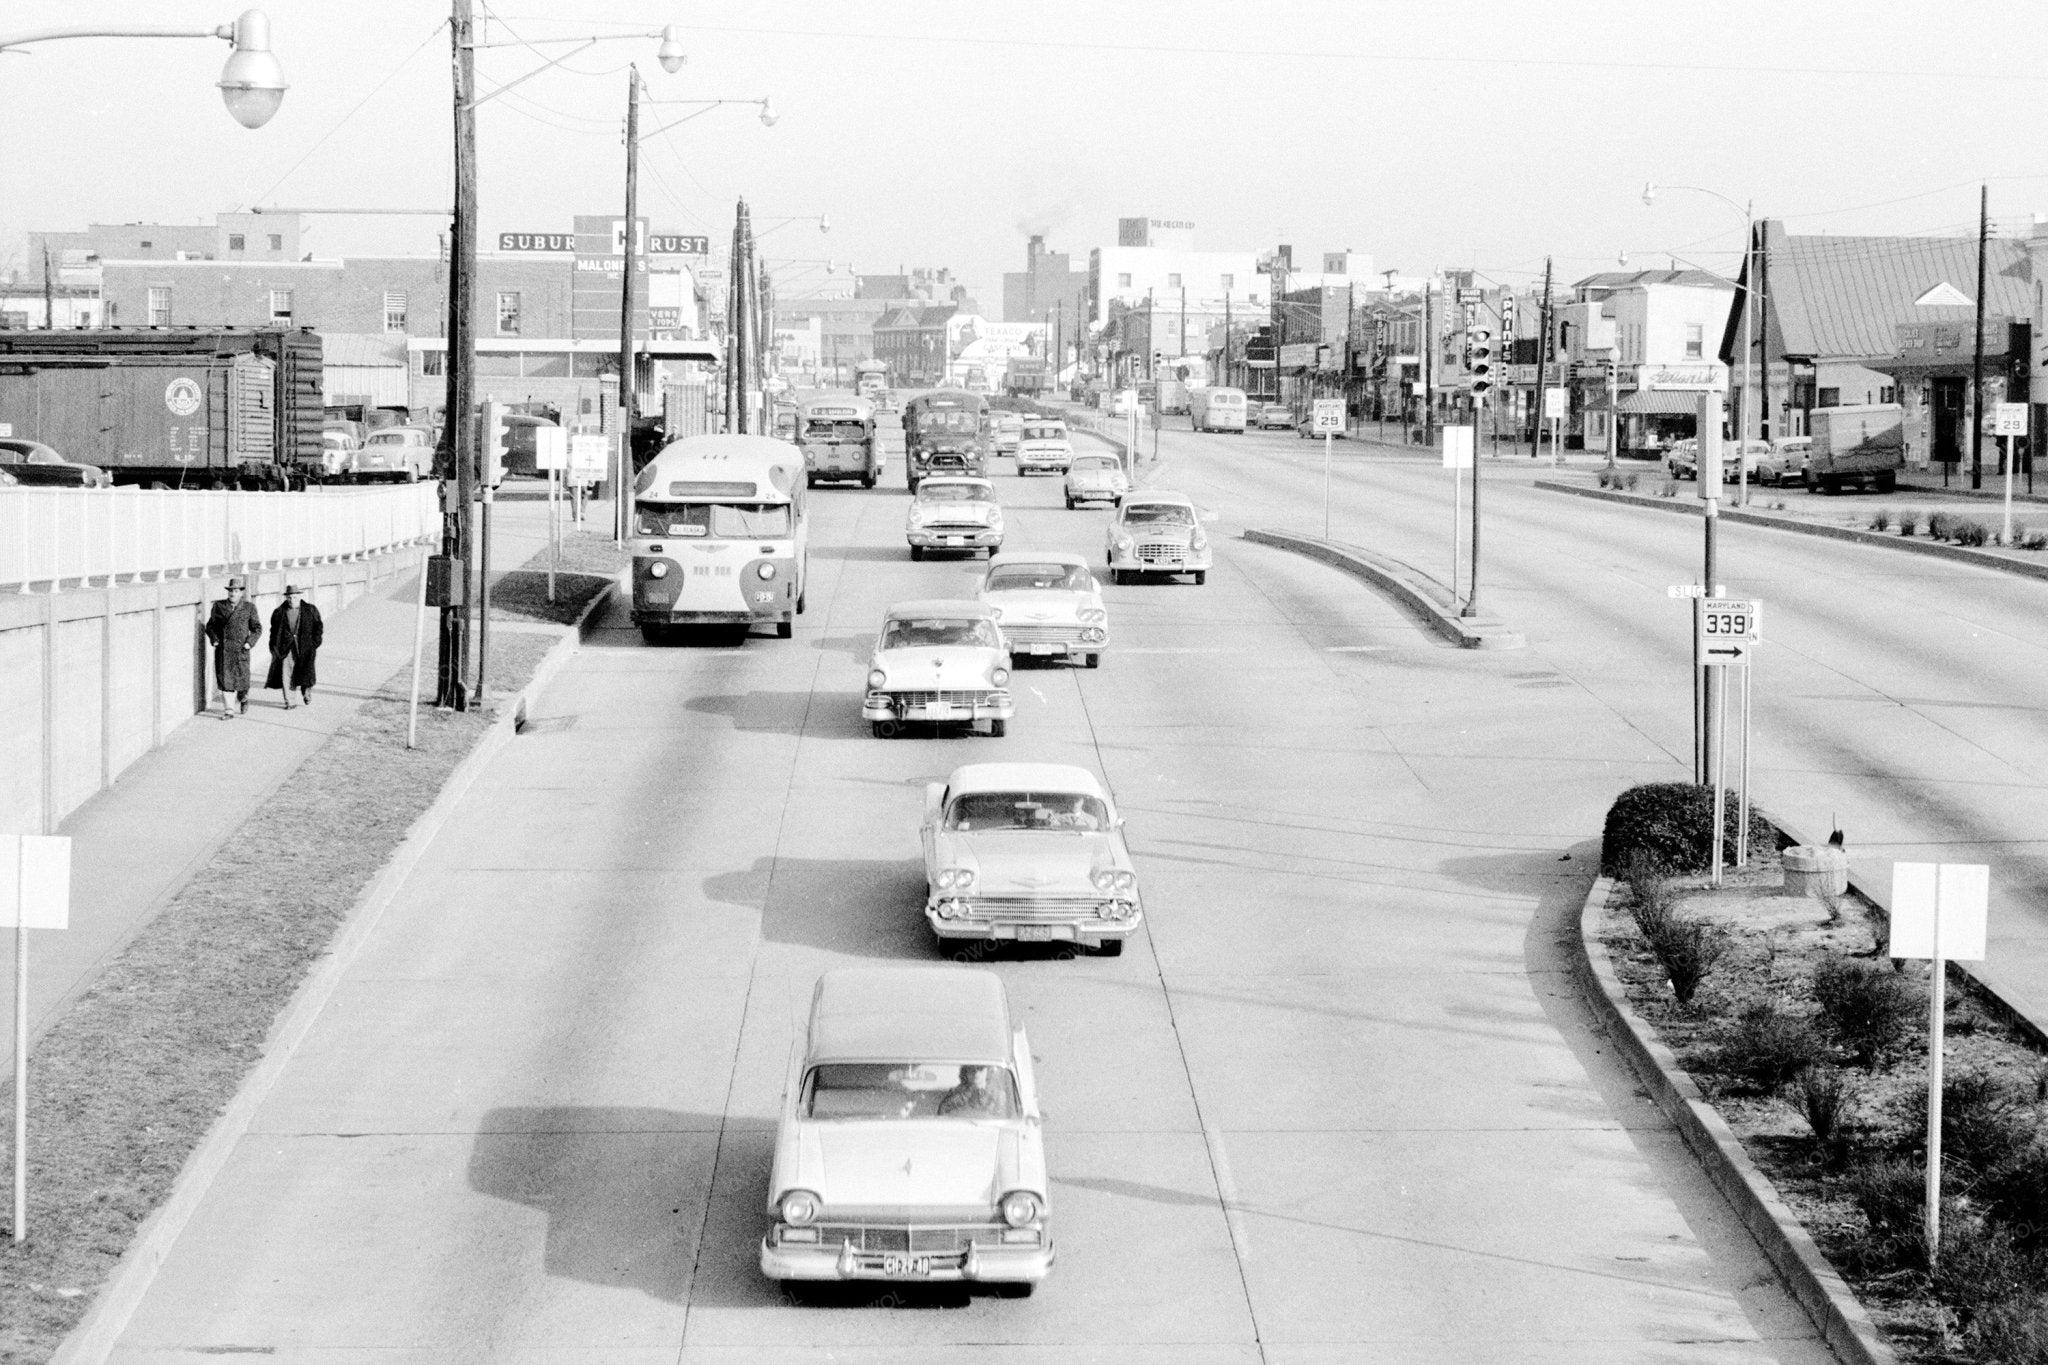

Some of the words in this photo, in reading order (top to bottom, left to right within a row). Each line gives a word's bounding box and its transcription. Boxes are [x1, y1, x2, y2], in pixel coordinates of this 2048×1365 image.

[577, 260, 646, 272] MALONES
[985, 327, 1022, 336] TEXACO
[1502, 300, 1512, 361] PAINTS
[1321, 416, 1339, 426] 29
[2003, 420, 2020, 430] 29
[1675, 586, 1704, 598] SLIG
[1706, 602, 1746, 611] MARYLAND
[1706, 614, 1746, 635] 339
